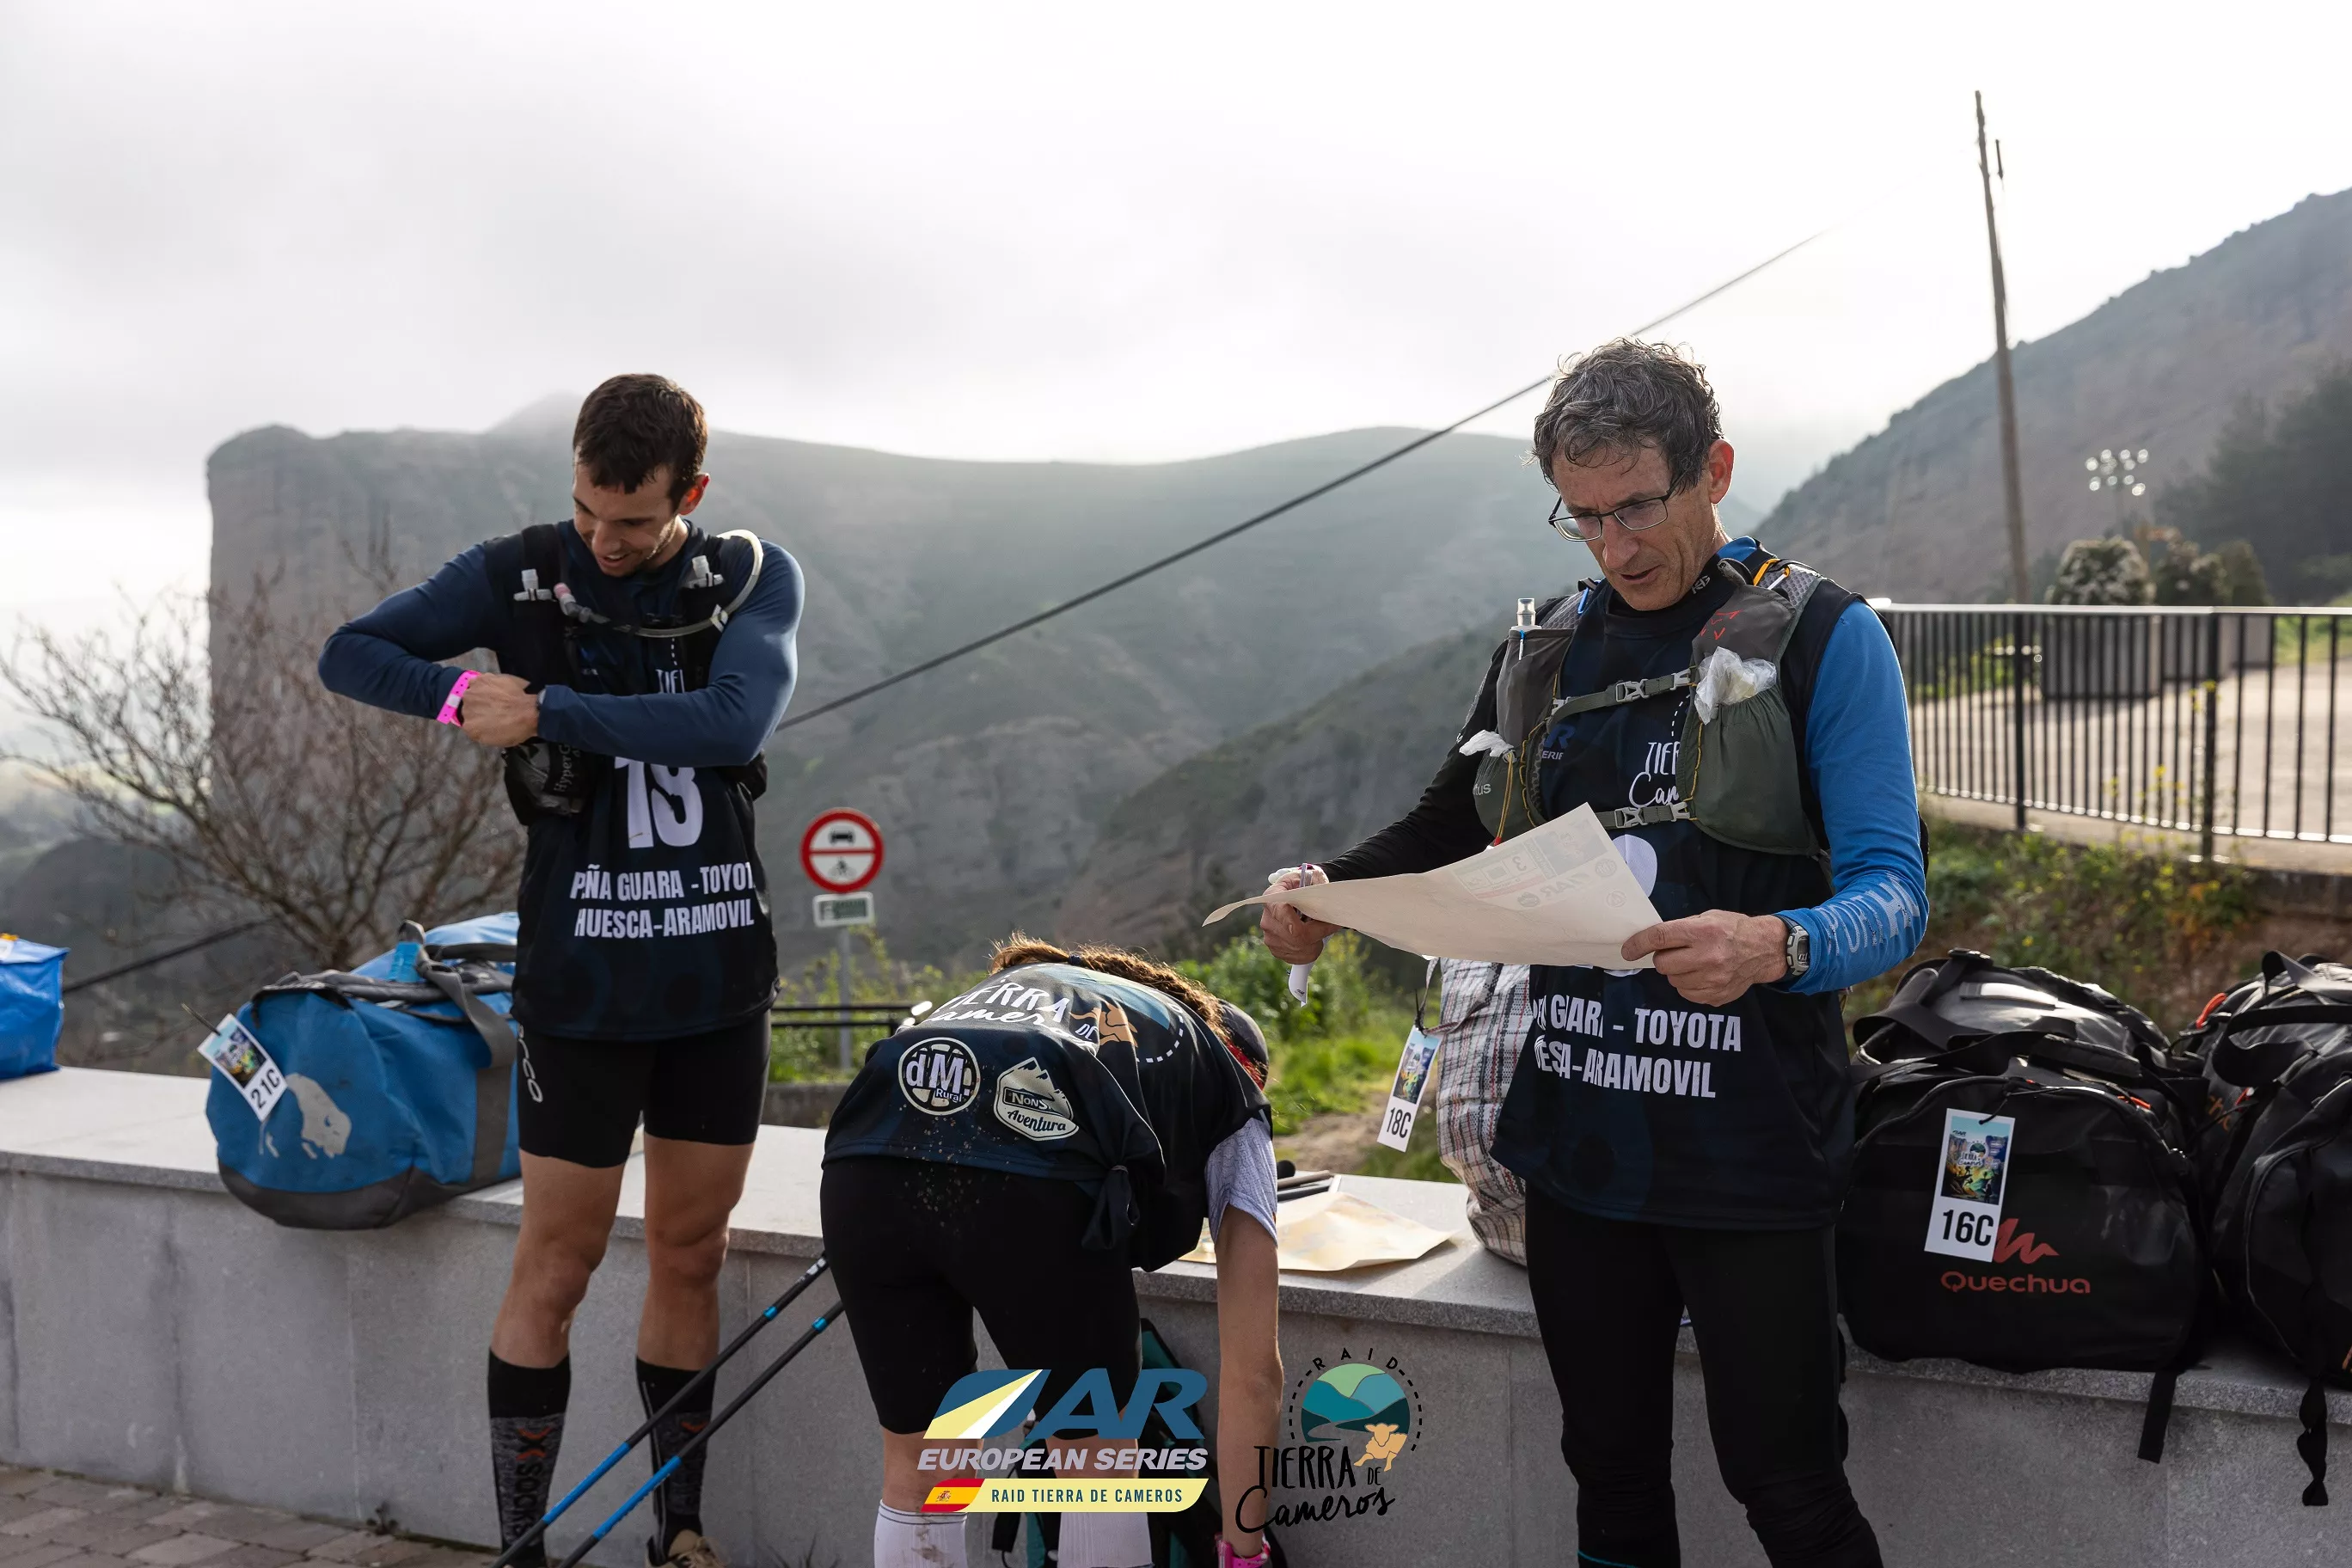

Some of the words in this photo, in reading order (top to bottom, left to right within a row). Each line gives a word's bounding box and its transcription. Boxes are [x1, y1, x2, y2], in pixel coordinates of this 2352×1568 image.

[569, 864, 612, 900] PÑA
[617, 870, 684, 901] GUARA
[574, 898, 755, 939] HUESCA-ARAMOVIL
[1635, 1008, 1742, 1052] TOYOTA
[250, 1069, 279, 1110] 21C
[935, 1088, 964, 1103] Rural
[1008, 1110, 1067, 1132] Aventura
[1387, 1107, 1412, 1138] 18C
[1943, 1209, 1994, 1246] 16C
[1940, 1271, 2091, 1294] Quechua
